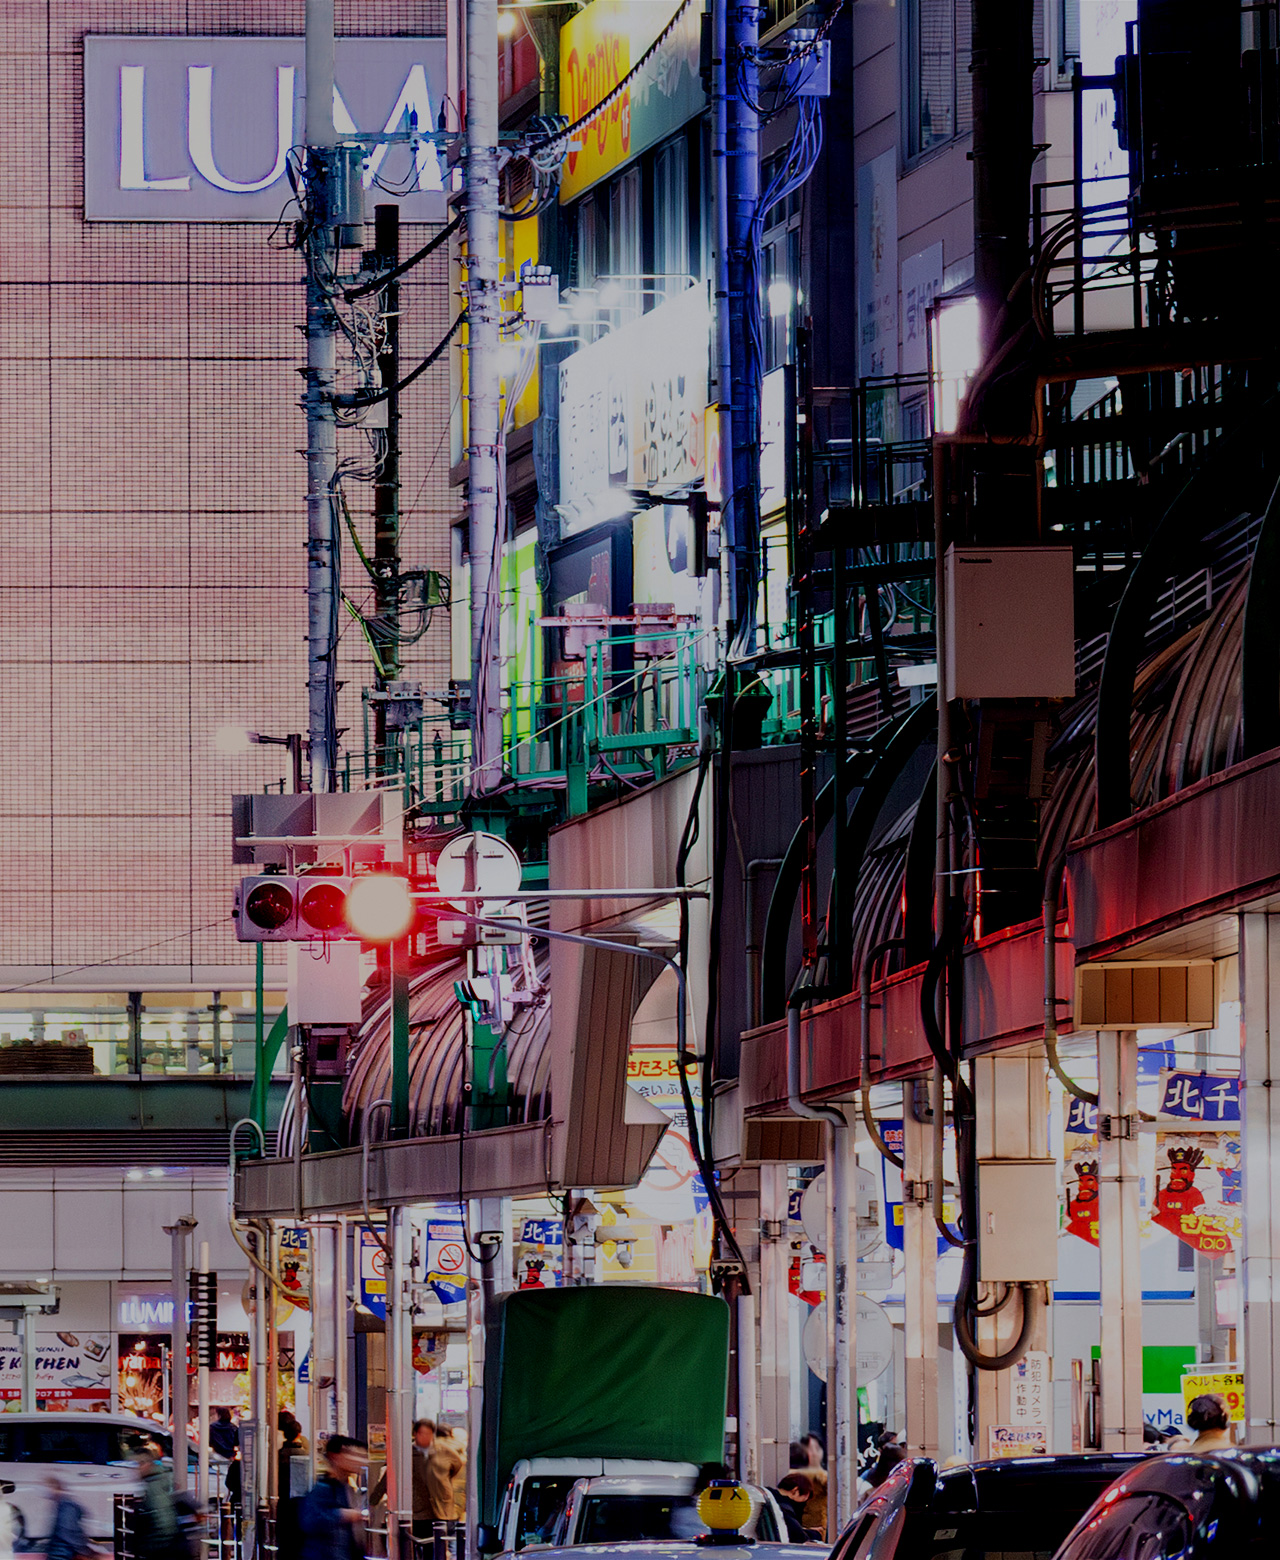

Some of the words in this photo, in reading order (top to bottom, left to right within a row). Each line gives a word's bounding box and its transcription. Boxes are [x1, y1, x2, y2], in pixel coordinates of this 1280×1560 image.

[1165, 1078, 1239, 1120] 北千
[524, 1222, 563, 1245] 北千
[1199, 1236, 1227, 1250] 1010
[1016, 1383, 1028, 1417] 作動中
[1030, 1358, 1042, 1418] 防犯カメラ
